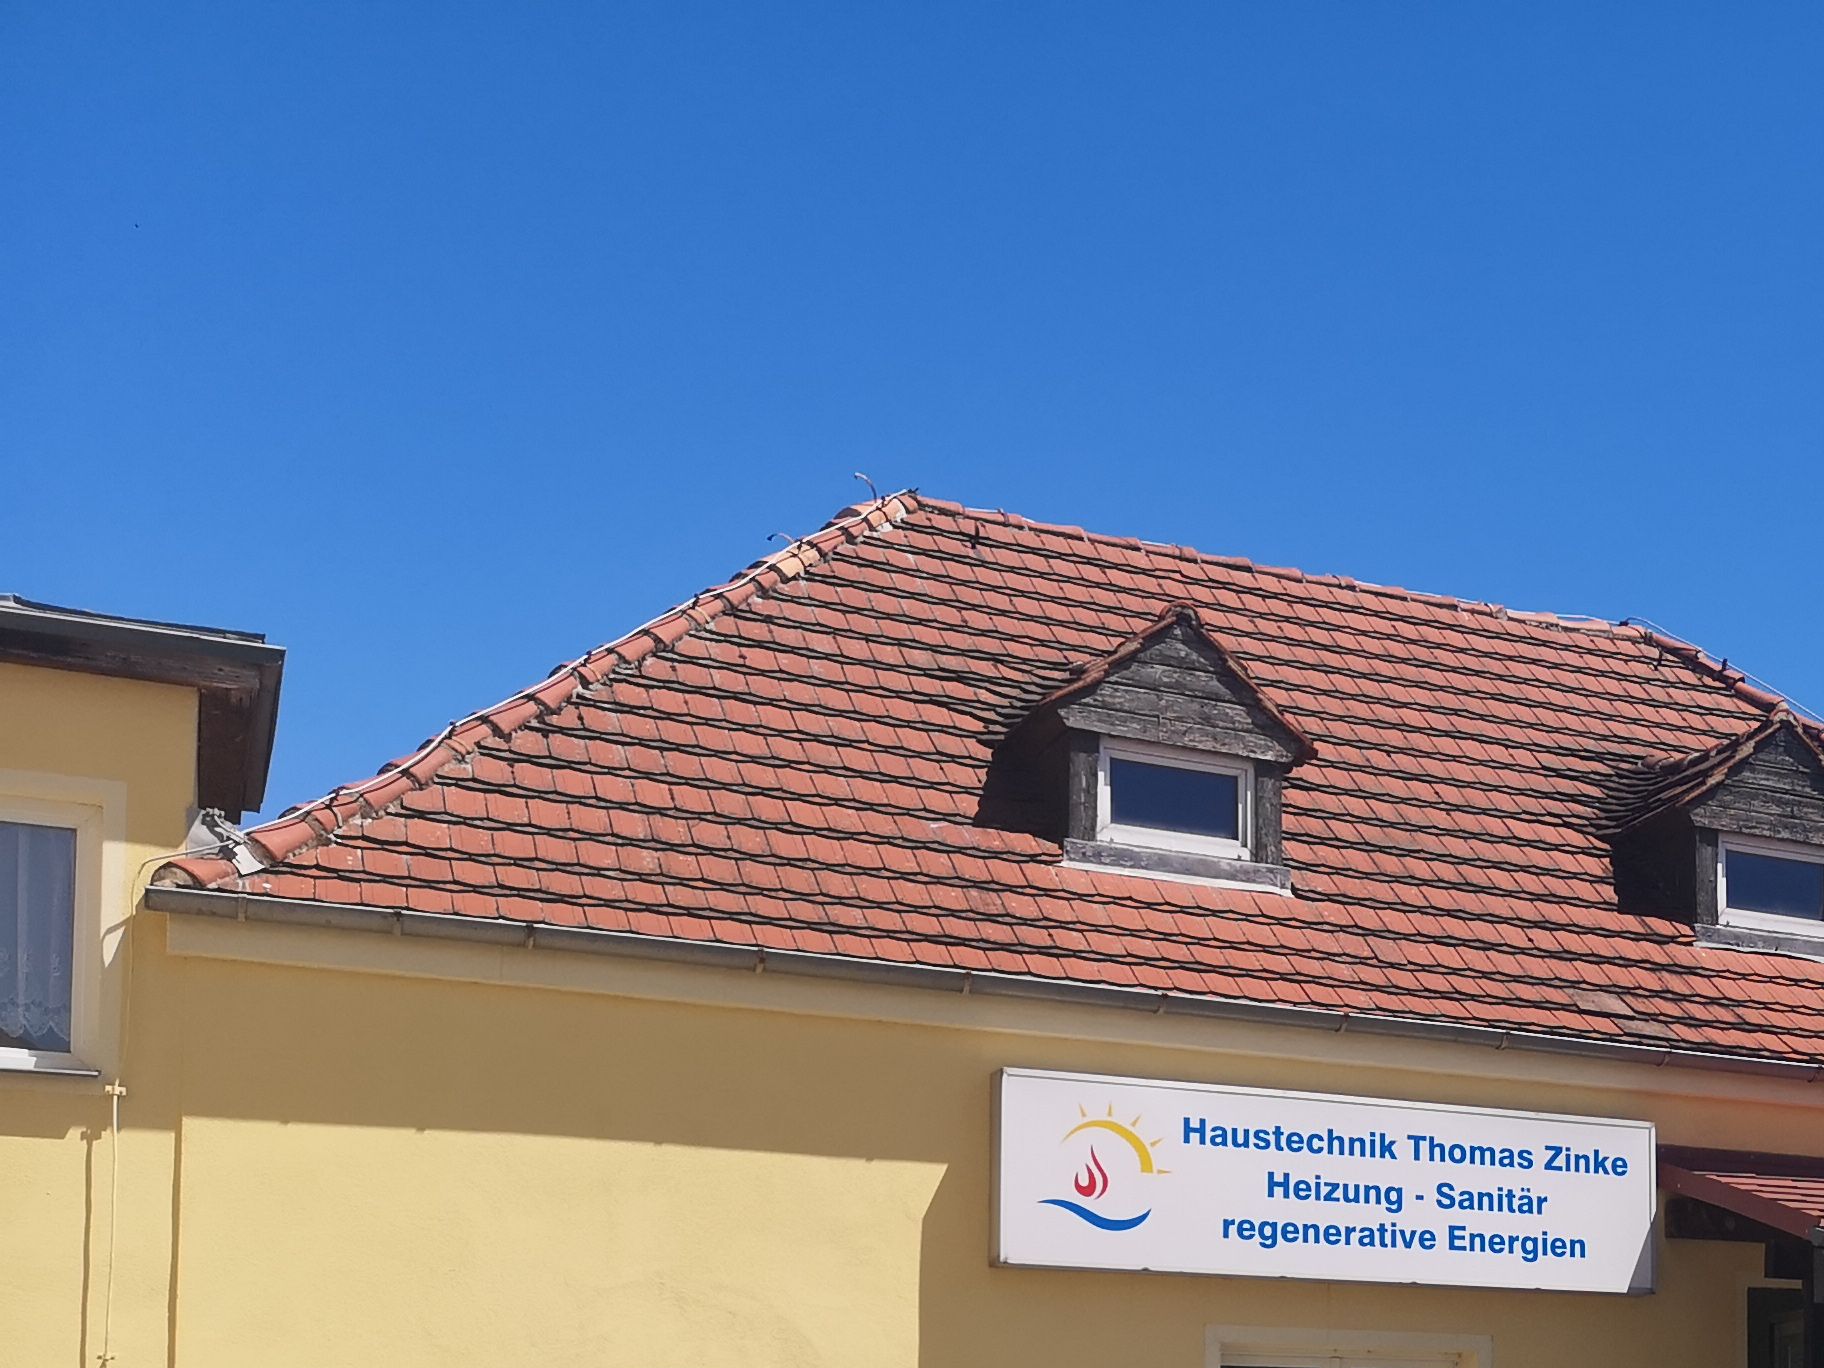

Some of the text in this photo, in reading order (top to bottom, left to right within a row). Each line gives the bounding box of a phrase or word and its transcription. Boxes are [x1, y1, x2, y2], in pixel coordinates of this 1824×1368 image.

[1182, 1116, 1630, 1178] Haustechnik Thomas Zinke
[1266, 1170, 1404, 1215] Heizung
[1435, 1182, 1550, 1216] Sanitär
[1221, 1217, 1588, 1264] regenerative Energien
